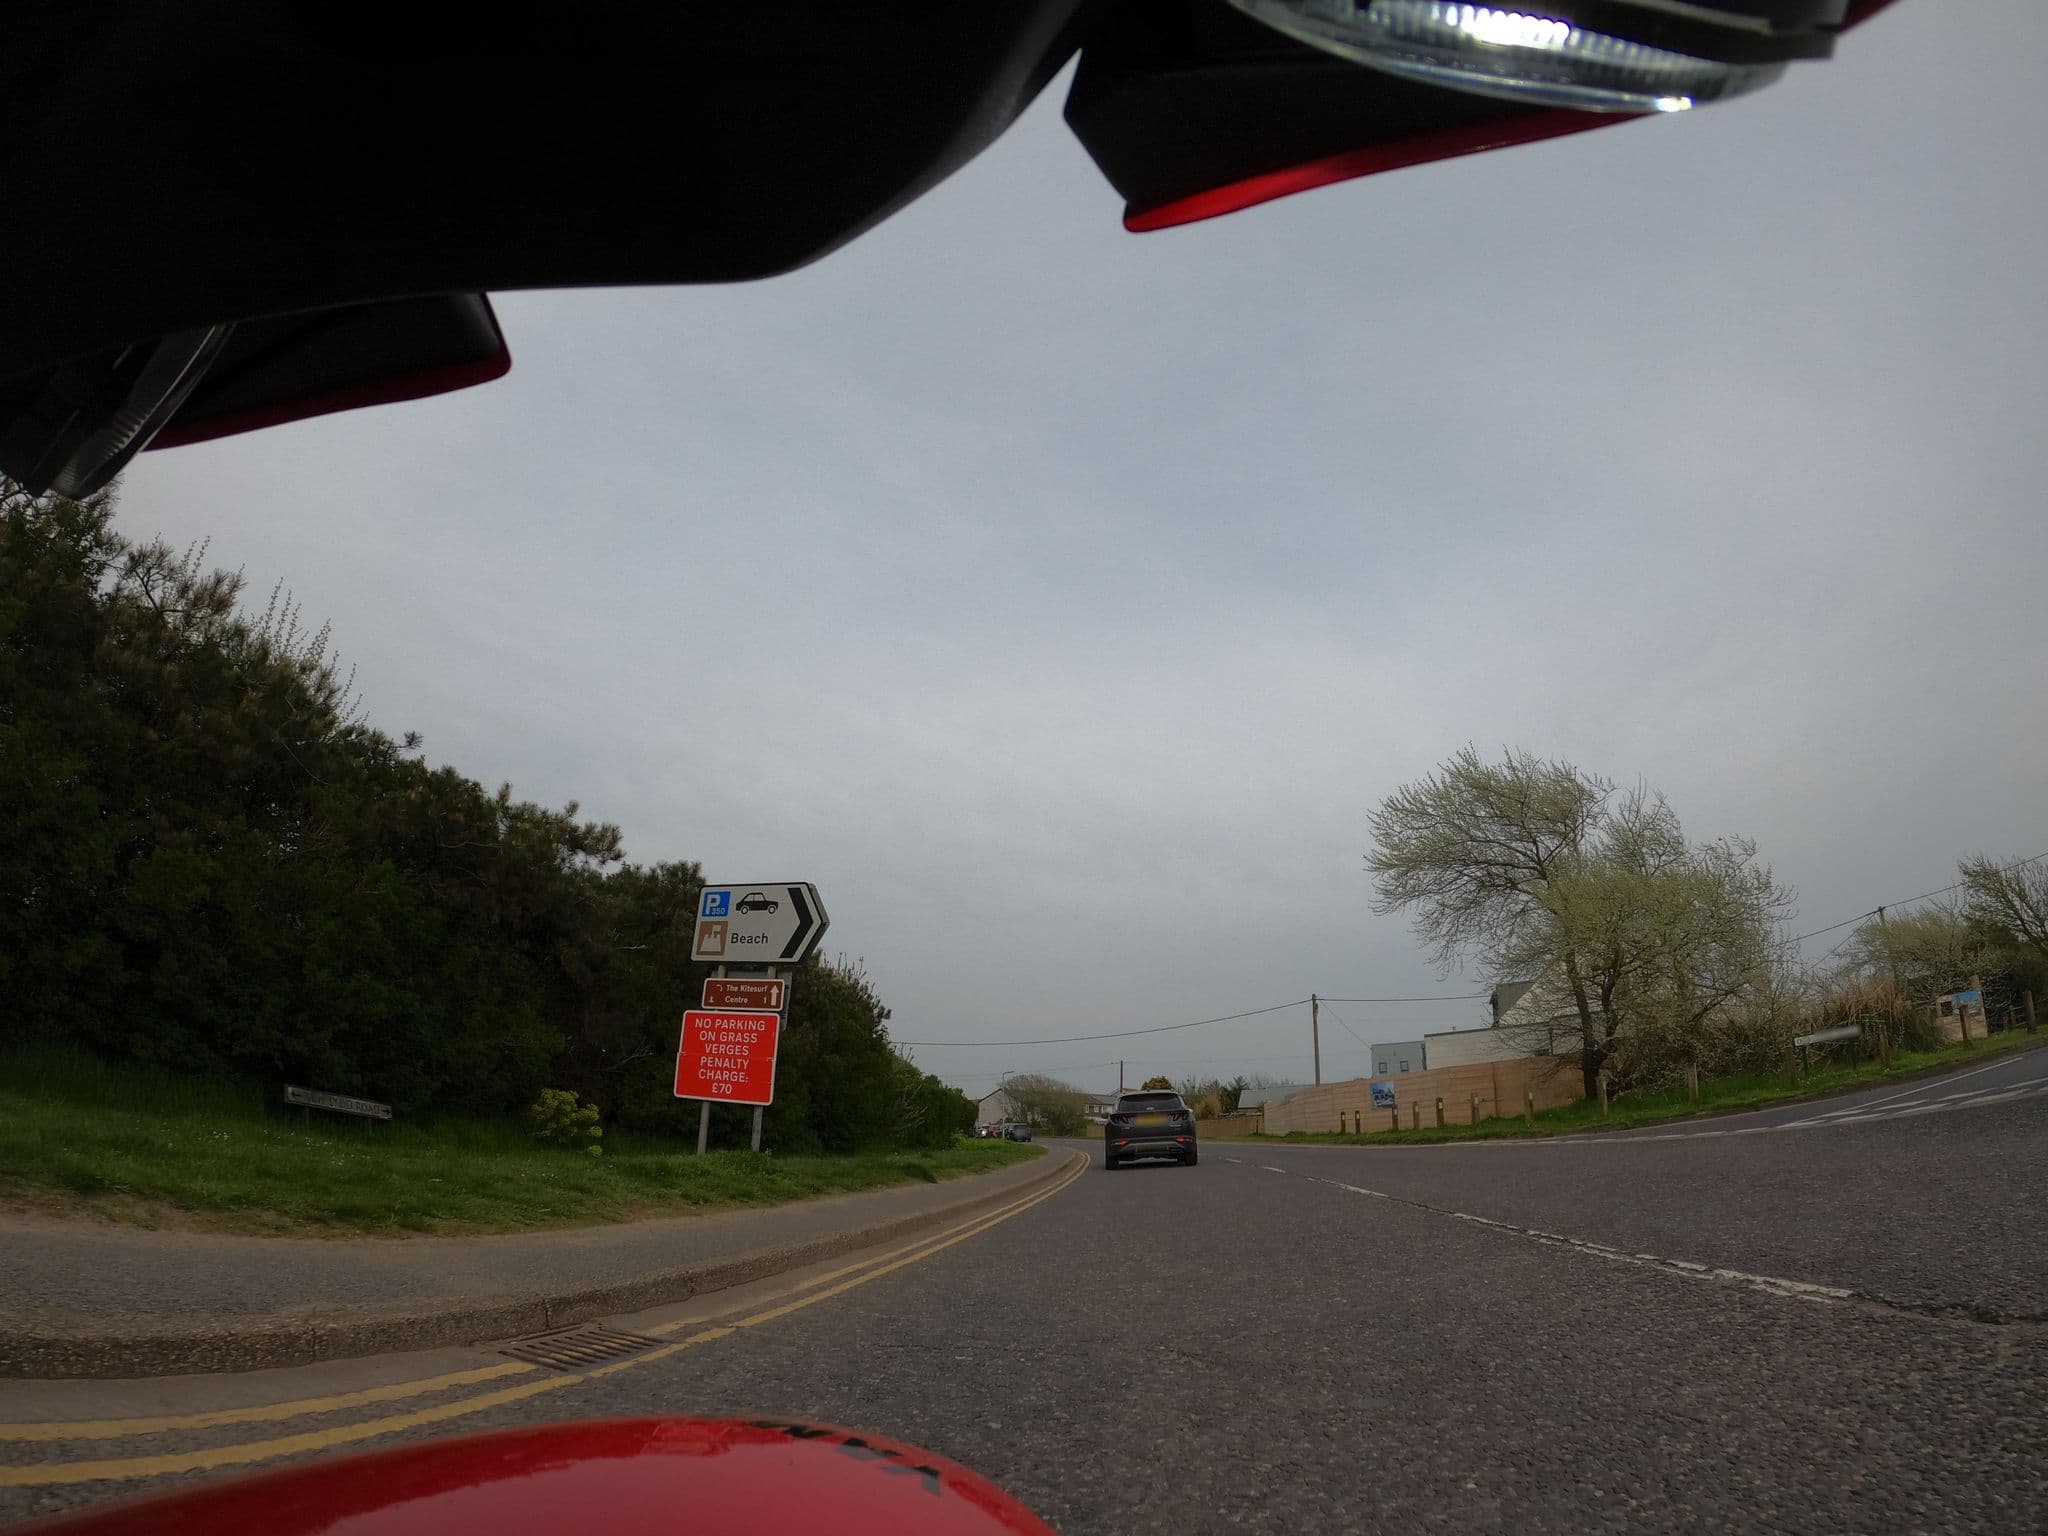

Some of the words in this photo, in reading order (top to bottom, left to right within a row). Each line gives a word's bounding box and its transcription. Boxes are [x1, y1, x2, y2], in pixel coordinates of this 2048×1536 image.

[706, 894, 720, 915] P
[730, 932, 769, 944] Beach
[726, 984, 738, 992] The
[740, 984, 768, 993] Kitesurf
[724, 995, 749, 1004] Centre
[695, 1018, 712, 1029] NO
[715, 1018, 766, 1031] PARKING
[699, 1030, 716, 1041] ON
[719, 1031, 758, 1043] GRASS
[705, 1043, 749, 1055] VERGES
[700, 1056, 750, 1070] PENALTY
[711, 1082, 733, 1094] £70
[355, 1101, 380, 1115] ROAD
